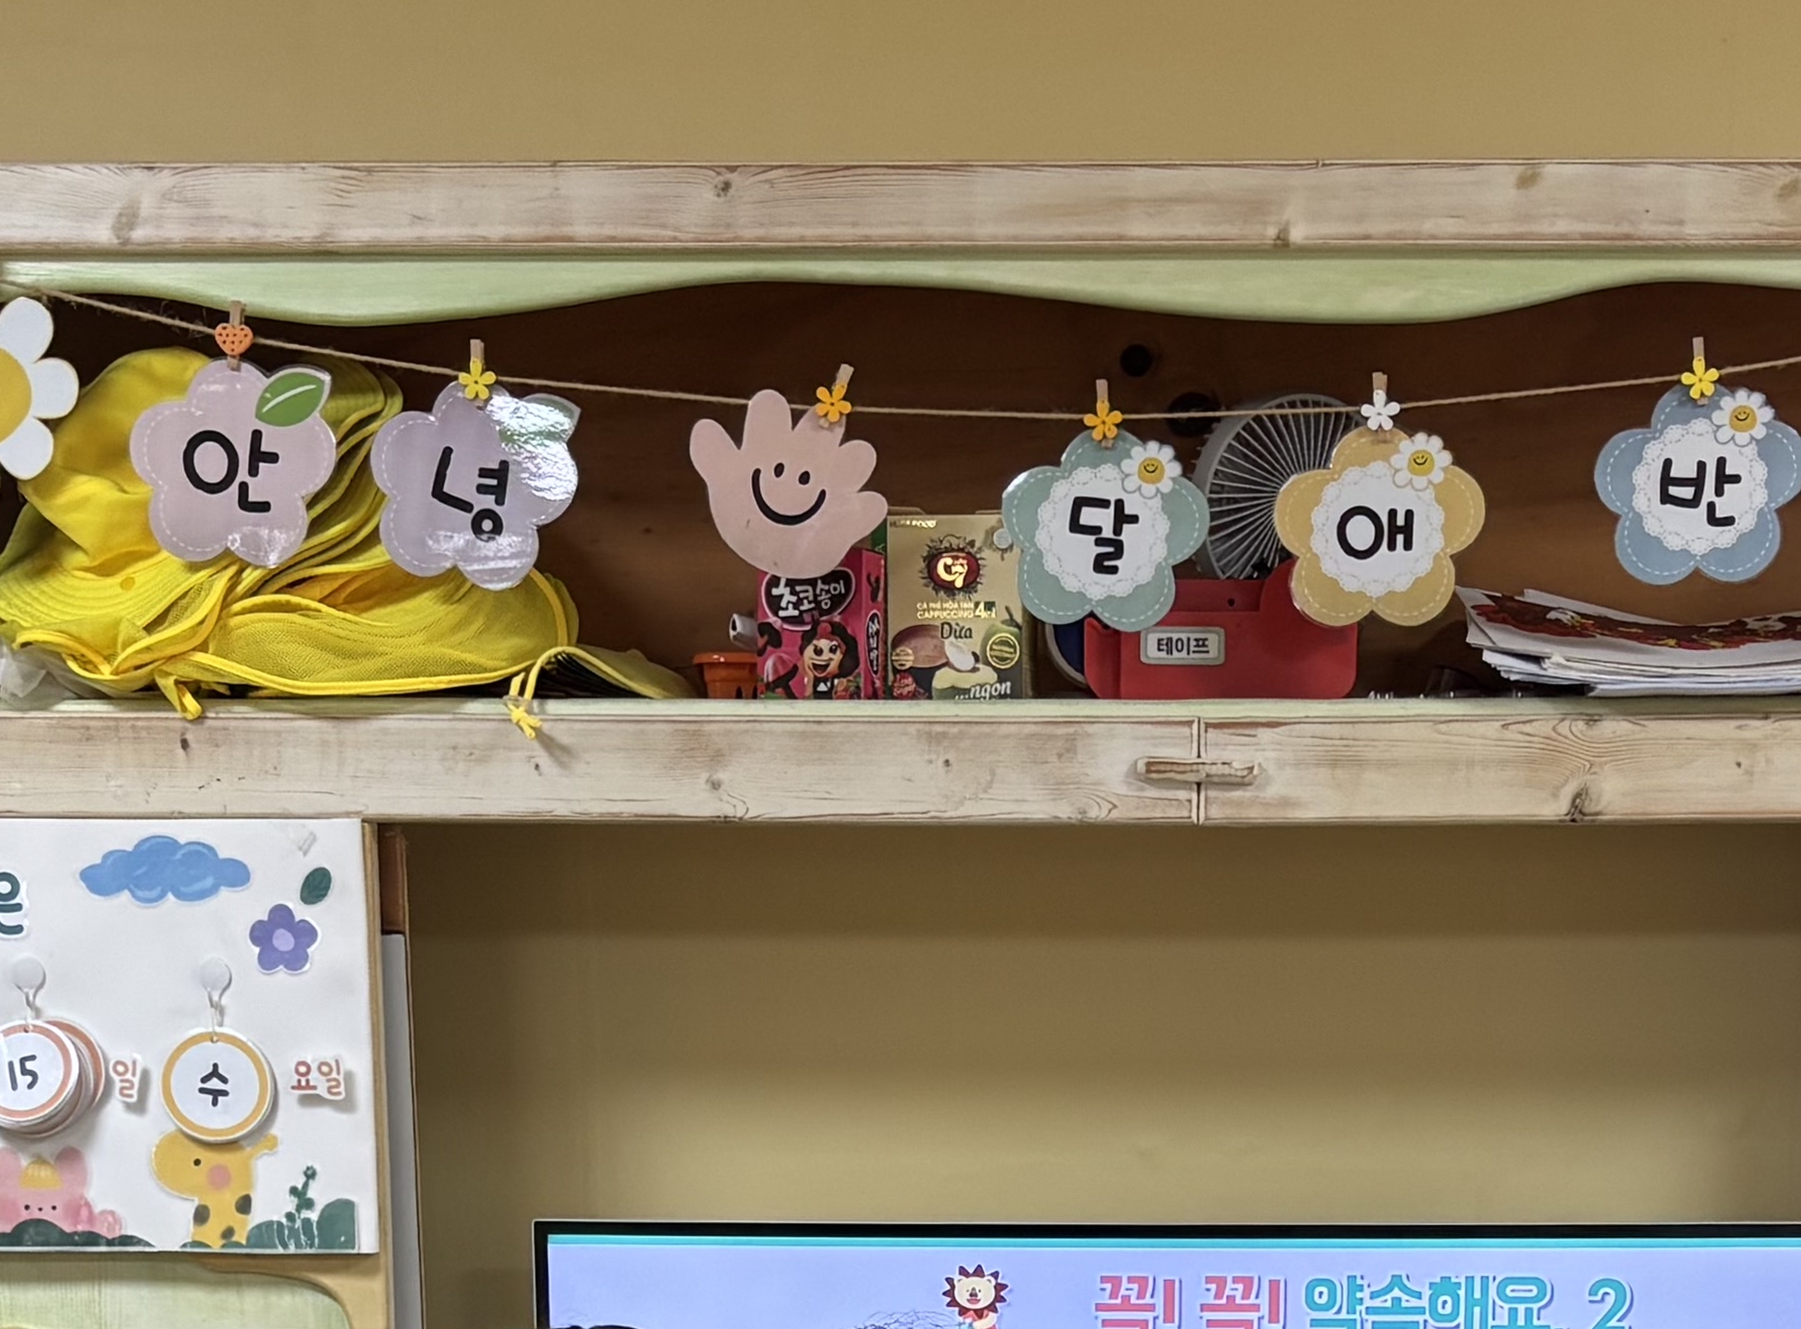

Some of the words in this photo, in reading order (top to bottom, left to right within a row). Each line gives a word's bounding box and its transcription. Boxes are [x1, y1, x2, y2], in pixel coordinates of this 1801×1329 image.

[1157, 636, 1210, 656] 테이프
[7, 1053, 39, 1092] 15
[112, 1059, 139, 1099] 일
[198, 1062, 230, 1107] 수
[290, 1058, 343, 1099] 요일
